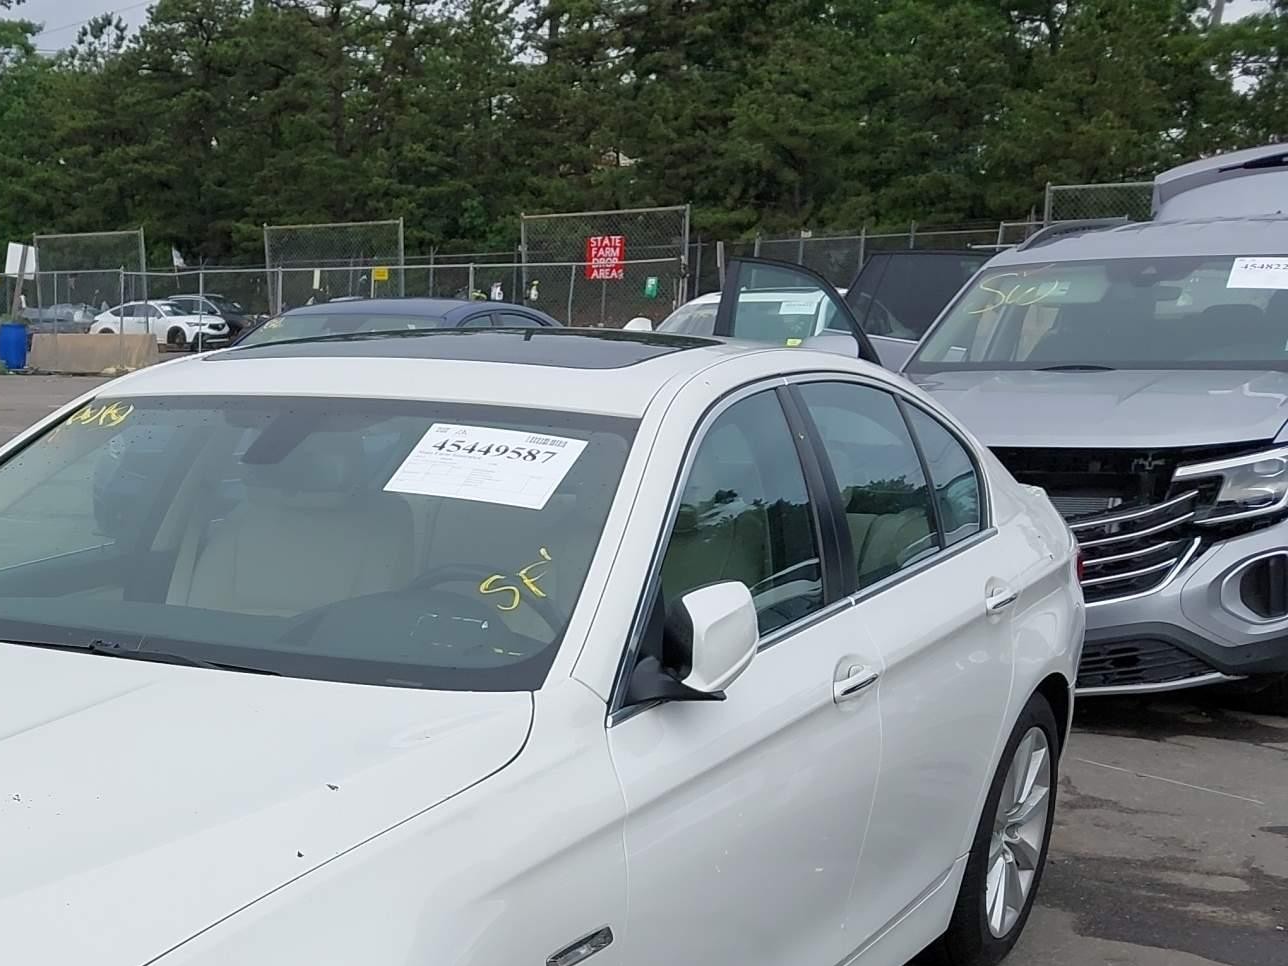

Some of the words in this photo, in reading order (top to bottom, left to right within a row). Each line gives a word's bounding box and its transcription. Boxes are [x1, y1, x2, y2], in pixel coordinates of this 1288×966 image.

[590, 235, 623, 247] STATE
[591, 247, 620, 257] FARM
[591, 257, 619, 268] DROP
[590, 268, 618, 280] AREA
[432, 438, 558, 464] 45449587
